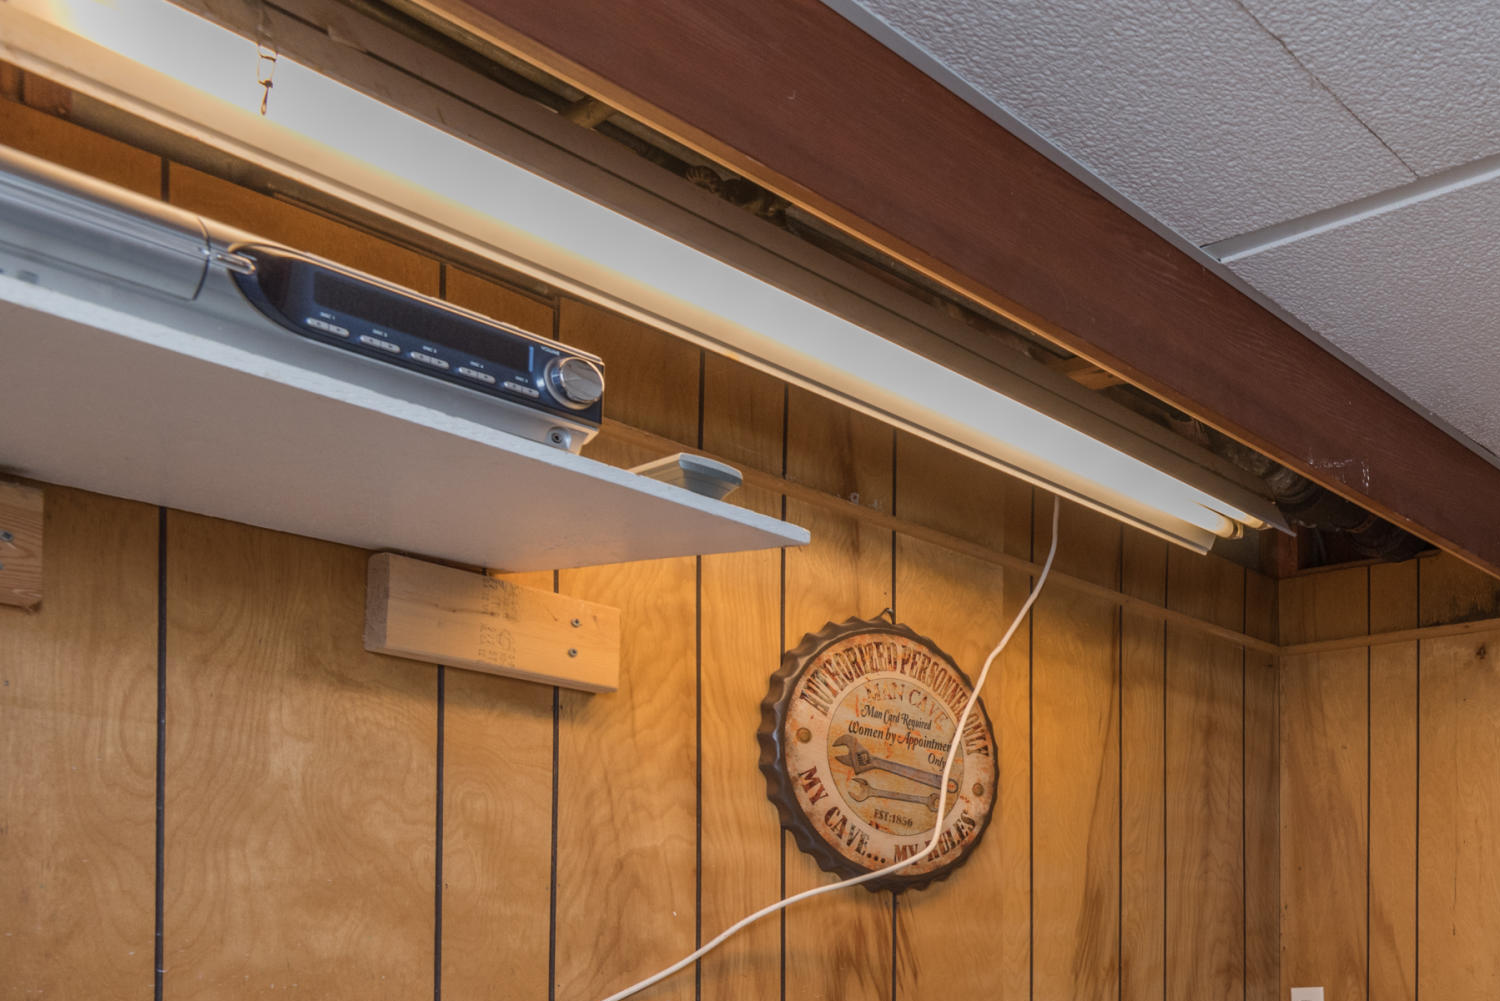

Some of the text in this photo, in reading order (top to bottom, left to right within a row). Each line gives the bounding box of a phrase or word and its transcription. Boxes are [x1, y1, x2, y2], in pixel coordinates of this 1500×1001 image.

[799, 641, 898, 717] AUTHORIZED
[861, 704, 932, 731] Man Card Required
[865, 681, 949, 731] MAN CAVE
[848, 720, 951, 752] Women by Appointmen
[798, 765, 829, 806] MY
[894, 843, 919, 866] MY
